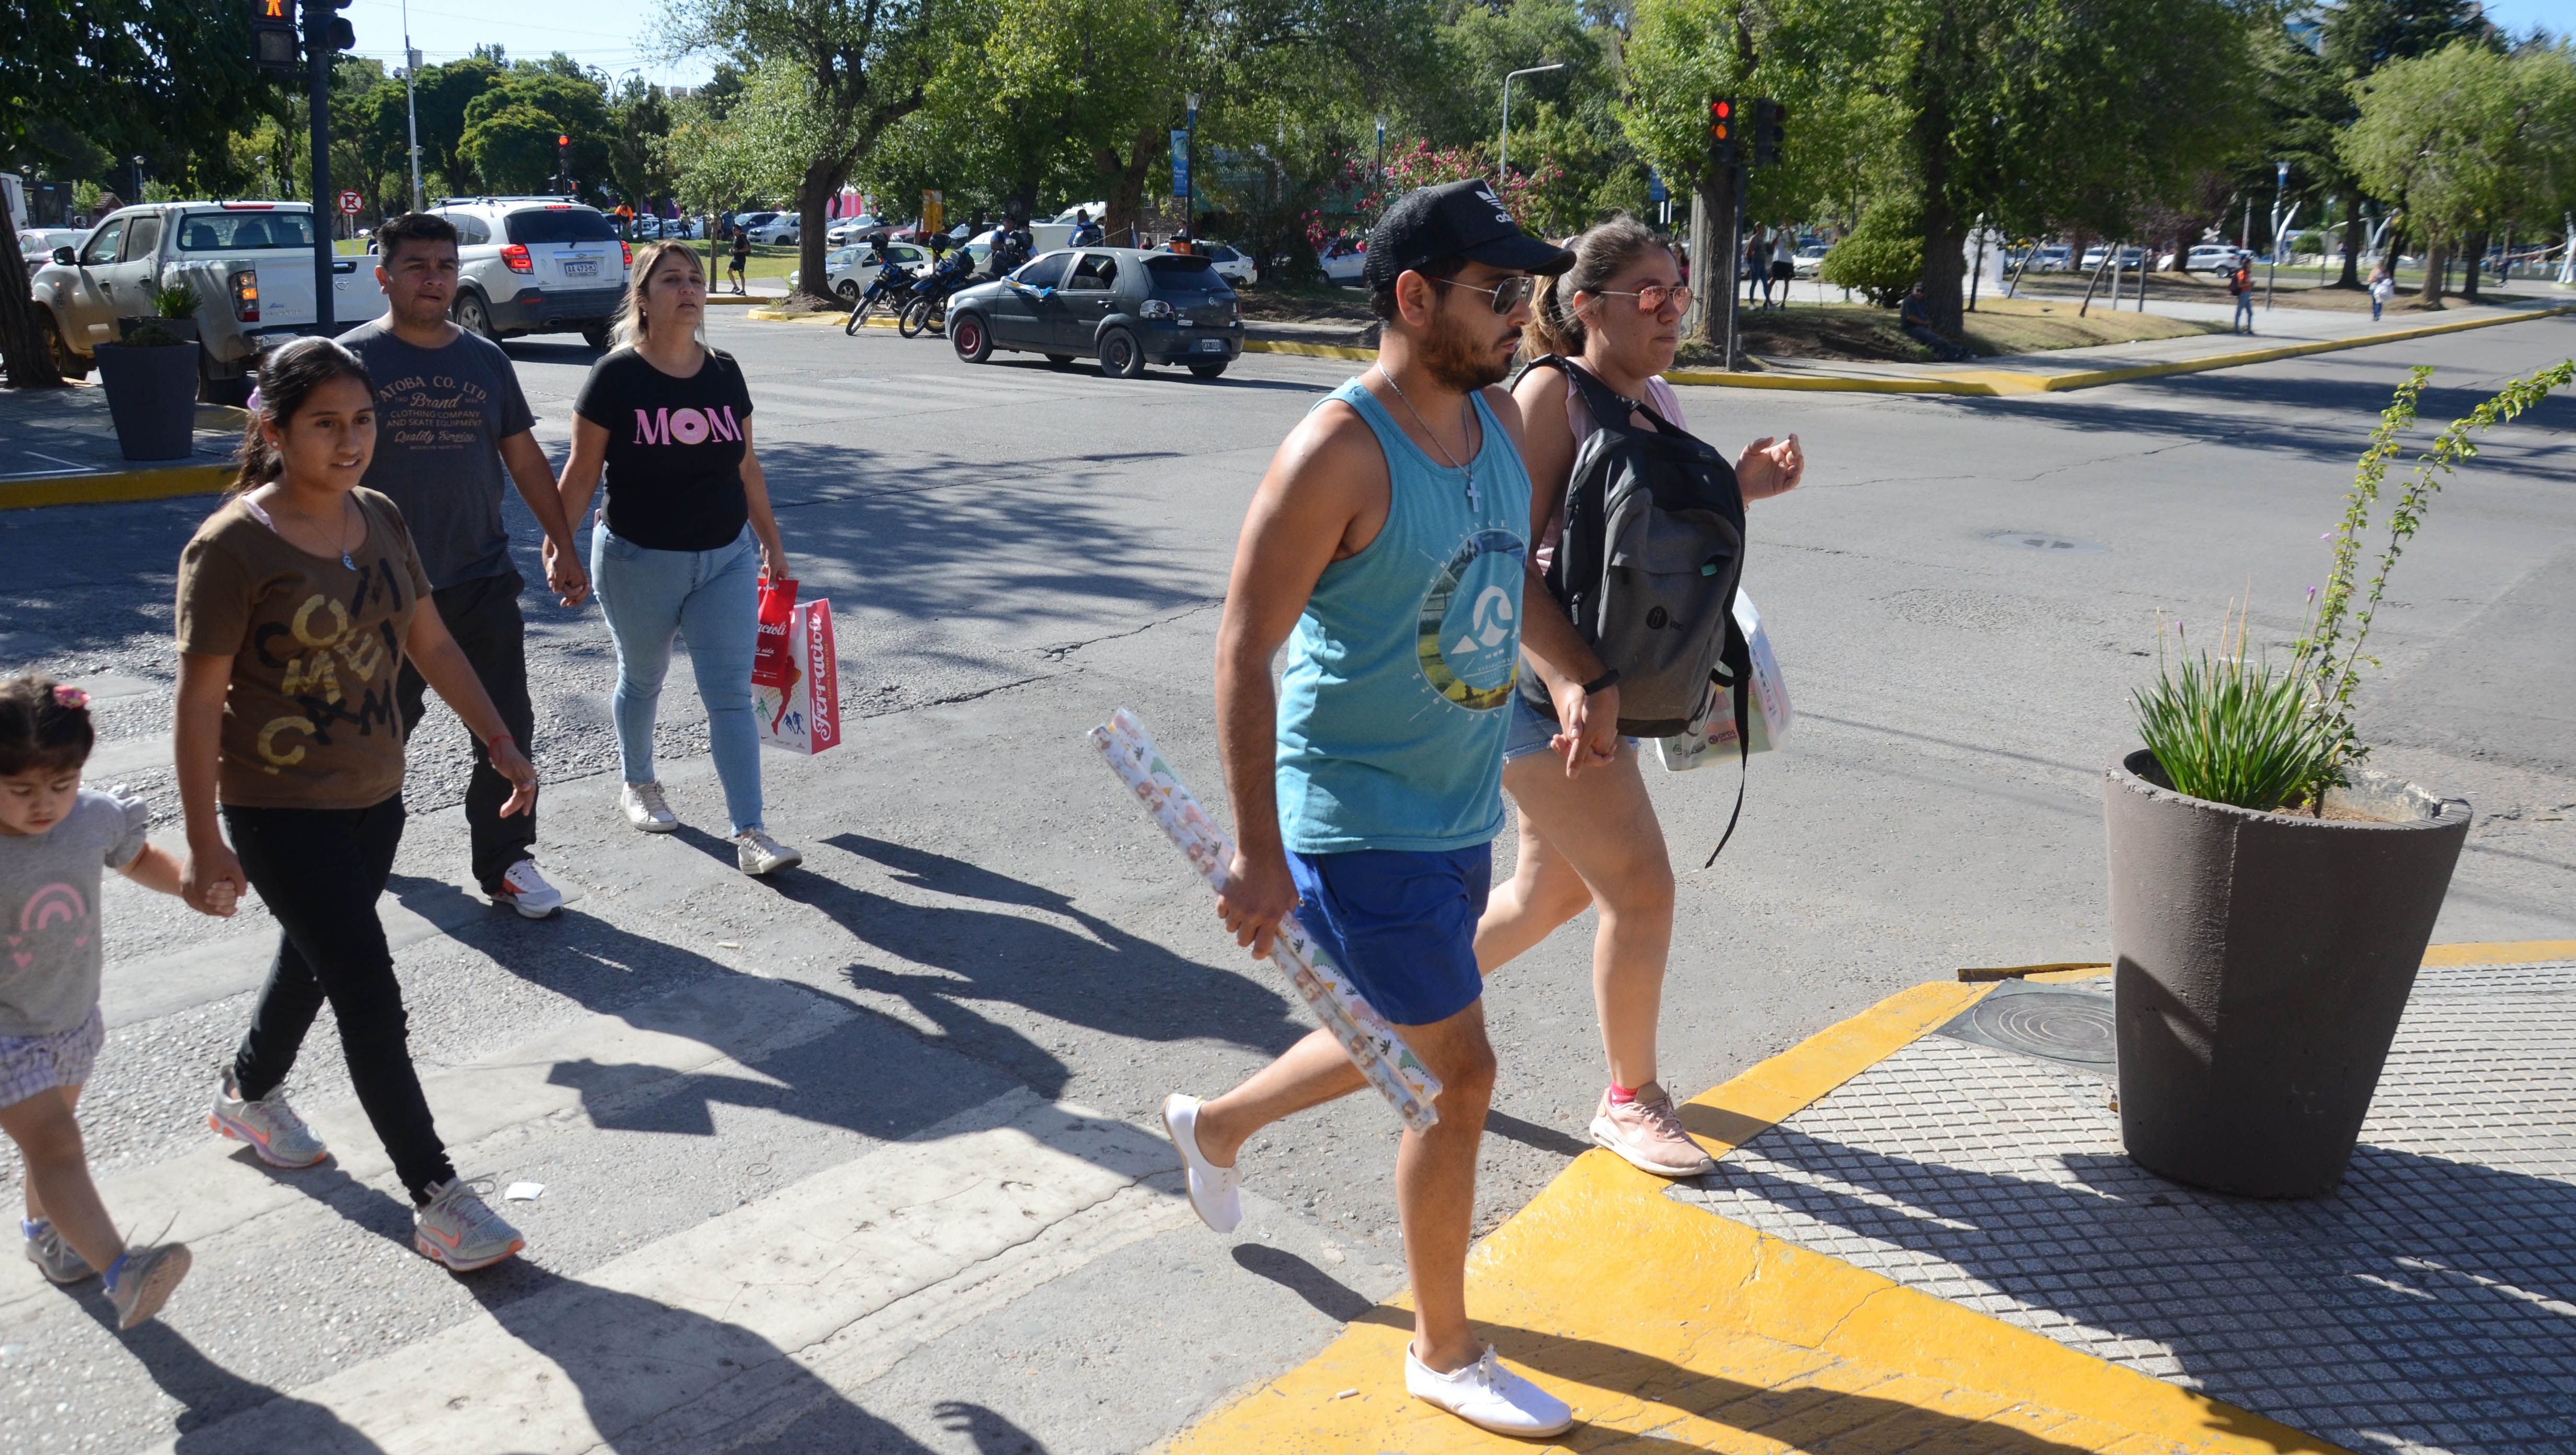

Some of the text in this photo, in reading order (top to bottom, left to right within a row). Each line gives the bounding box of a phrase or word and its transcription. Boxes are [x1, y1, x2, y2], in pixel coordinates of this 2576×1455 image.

[375, 376, 487, 403] ATOBA CO. LTD.
[410, 392, 464, 408] Brand
[390, 410, 481, 419] CLOTHING COMPANY
[386, 419, 407, 428] AND
[633, 405, 743, 446] MOM
[394, 430, 477, 444] Quality Service
[809, 613, 832, 741] Ferracioli
